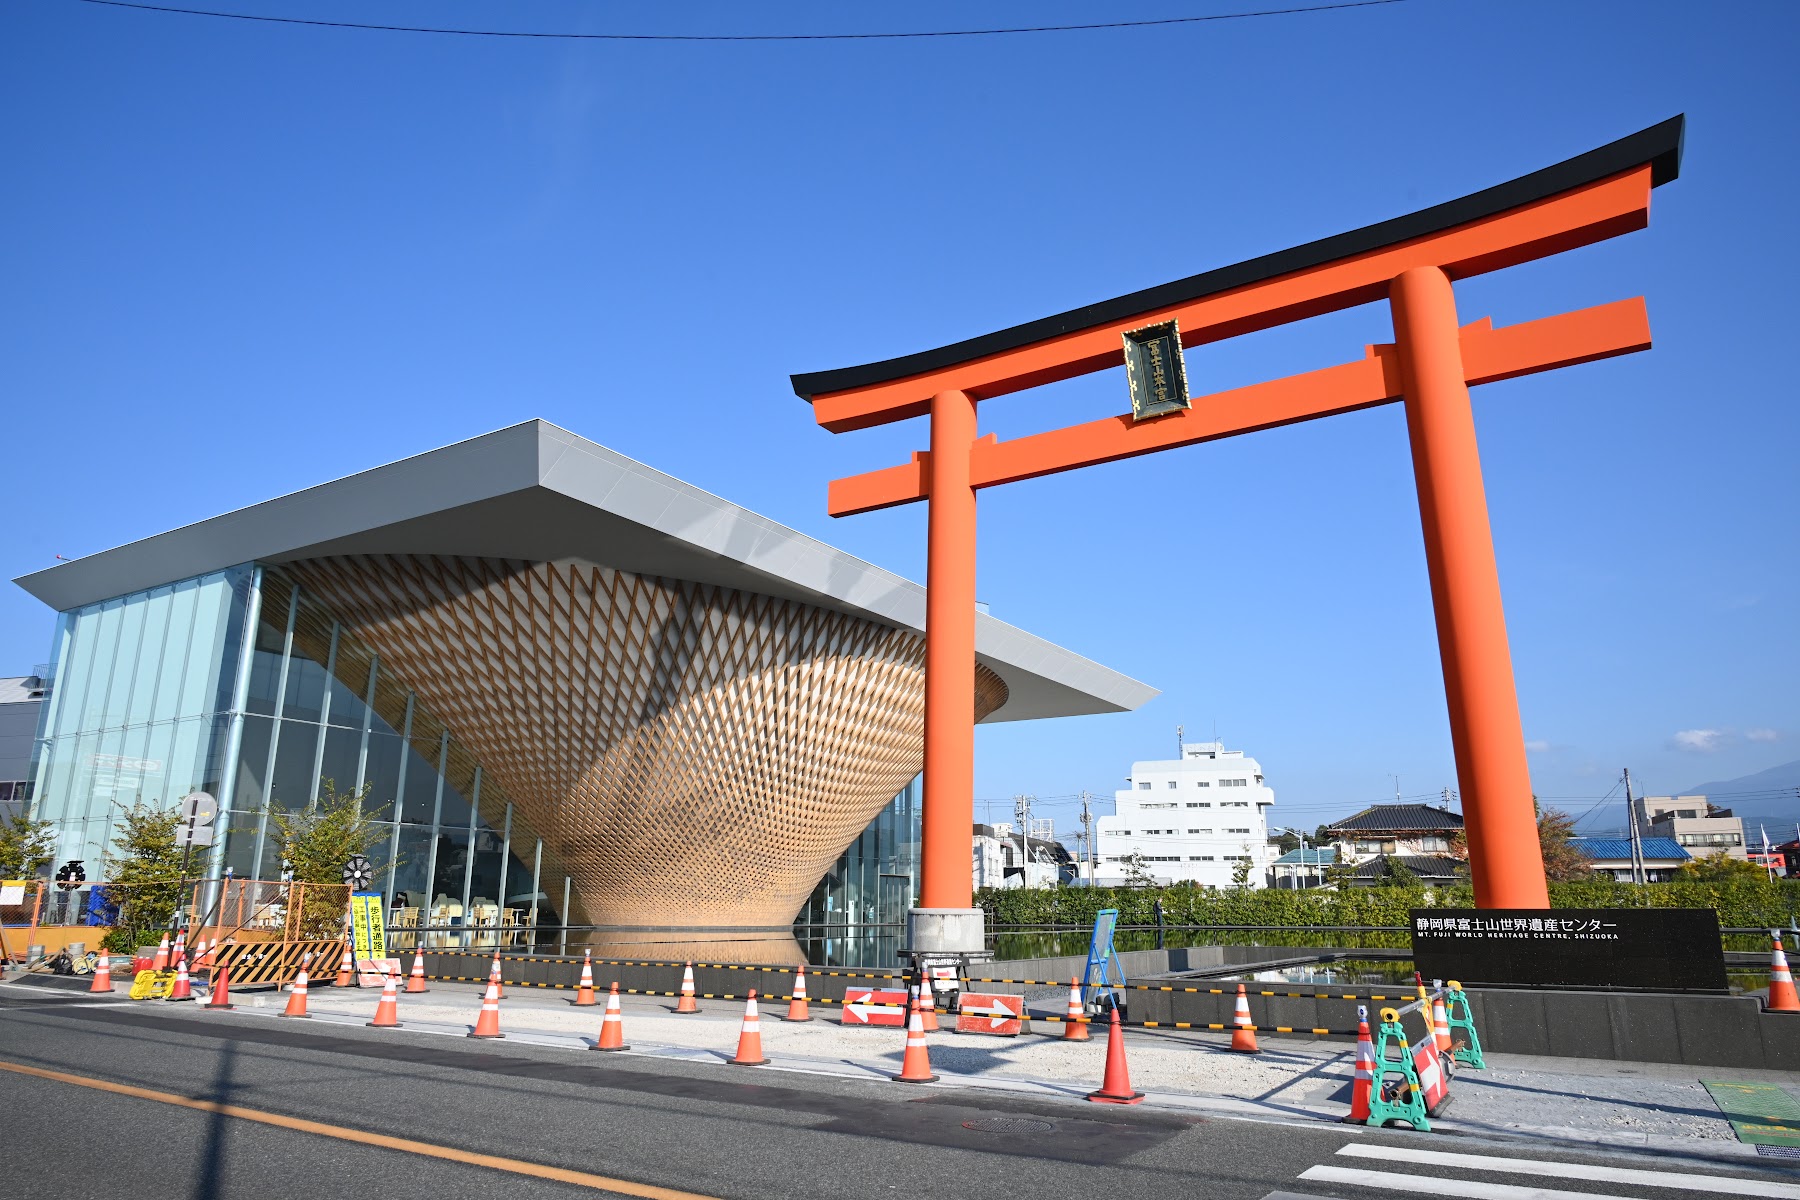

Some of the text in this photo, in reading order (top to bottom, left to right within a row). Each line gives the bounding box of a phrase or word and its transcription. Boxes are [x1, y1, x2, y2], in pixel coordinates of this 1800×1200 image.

[370, 906, 382, 949] 歩行者通路
[1416, 917, 1617, 931] 静岡県富士山世界遺産センター
[1533, 932, 1571, 940] CENTRE,
